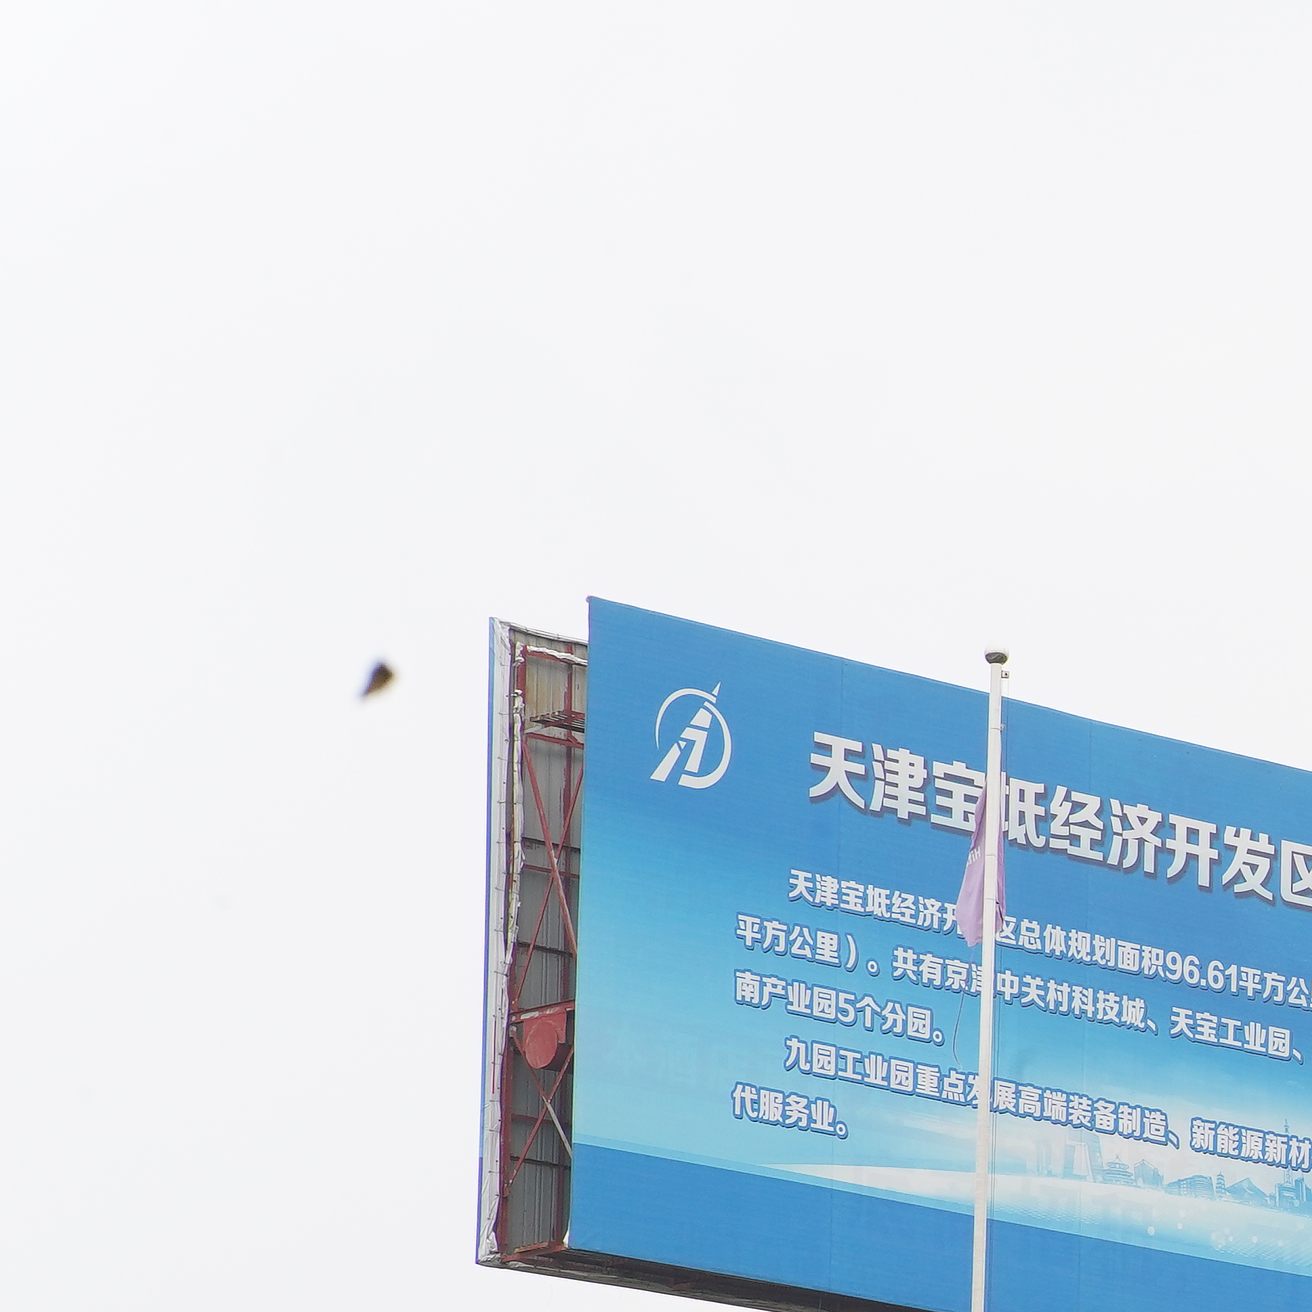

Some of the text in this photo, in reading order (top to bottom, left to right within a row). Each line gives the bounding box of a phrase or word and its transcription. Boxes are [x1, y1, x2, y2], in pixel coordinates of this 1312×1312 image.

[734, 971, 946, 1046] 南产业园5个分园。
[732, 1083, 849, 1139] 代服务业。
